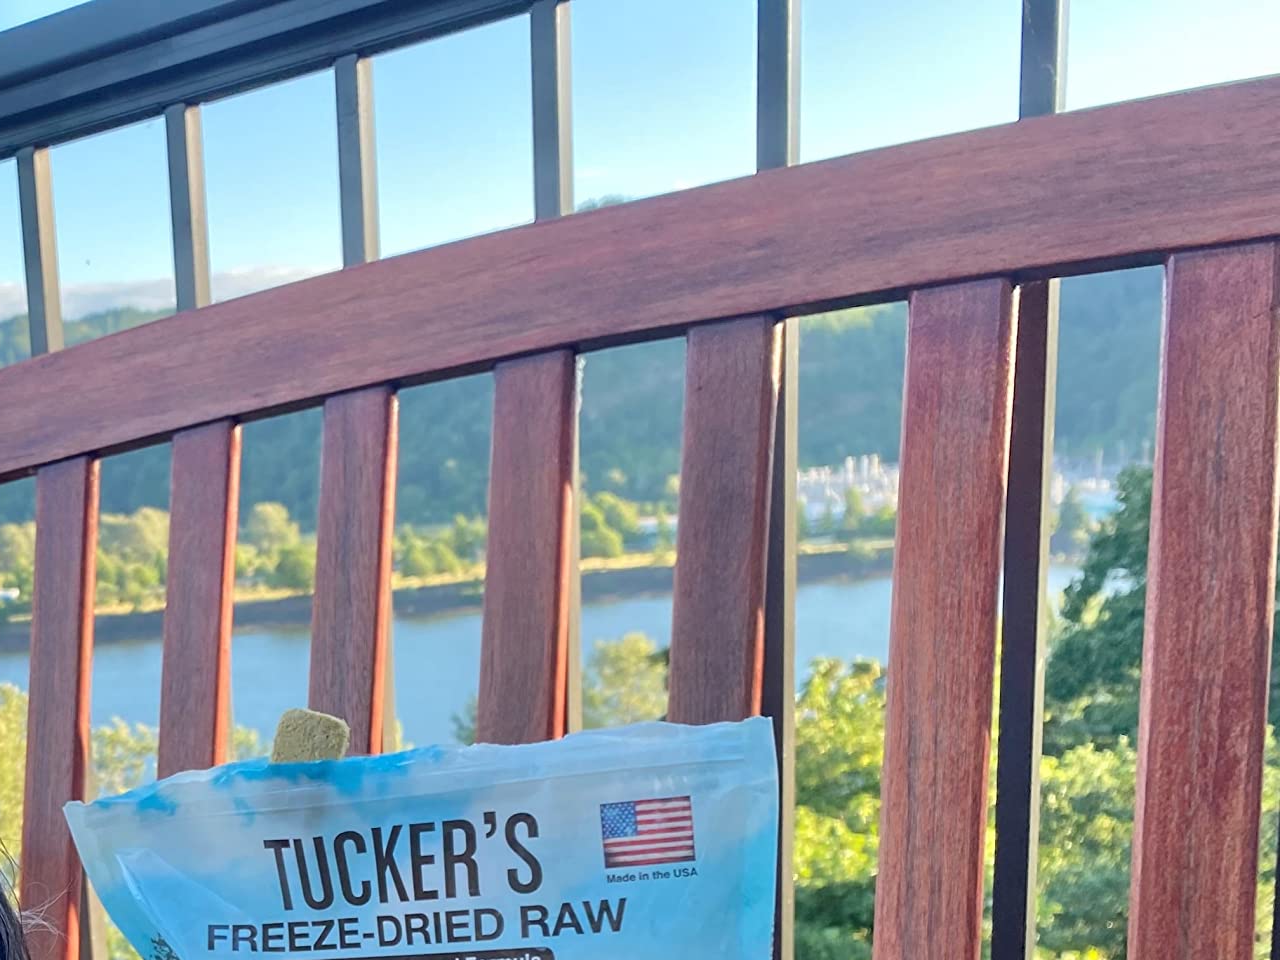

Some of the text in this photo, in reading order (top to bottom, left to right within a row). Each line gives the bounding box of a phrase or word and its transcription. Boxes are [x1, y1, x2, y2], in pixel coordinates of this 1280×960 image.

[263, 811, 543, 911] TUCKER'S
[606, 867, 698, 884] Made in the USA
[207, 898, 627, 953] FREEZE-DRIED RAW
